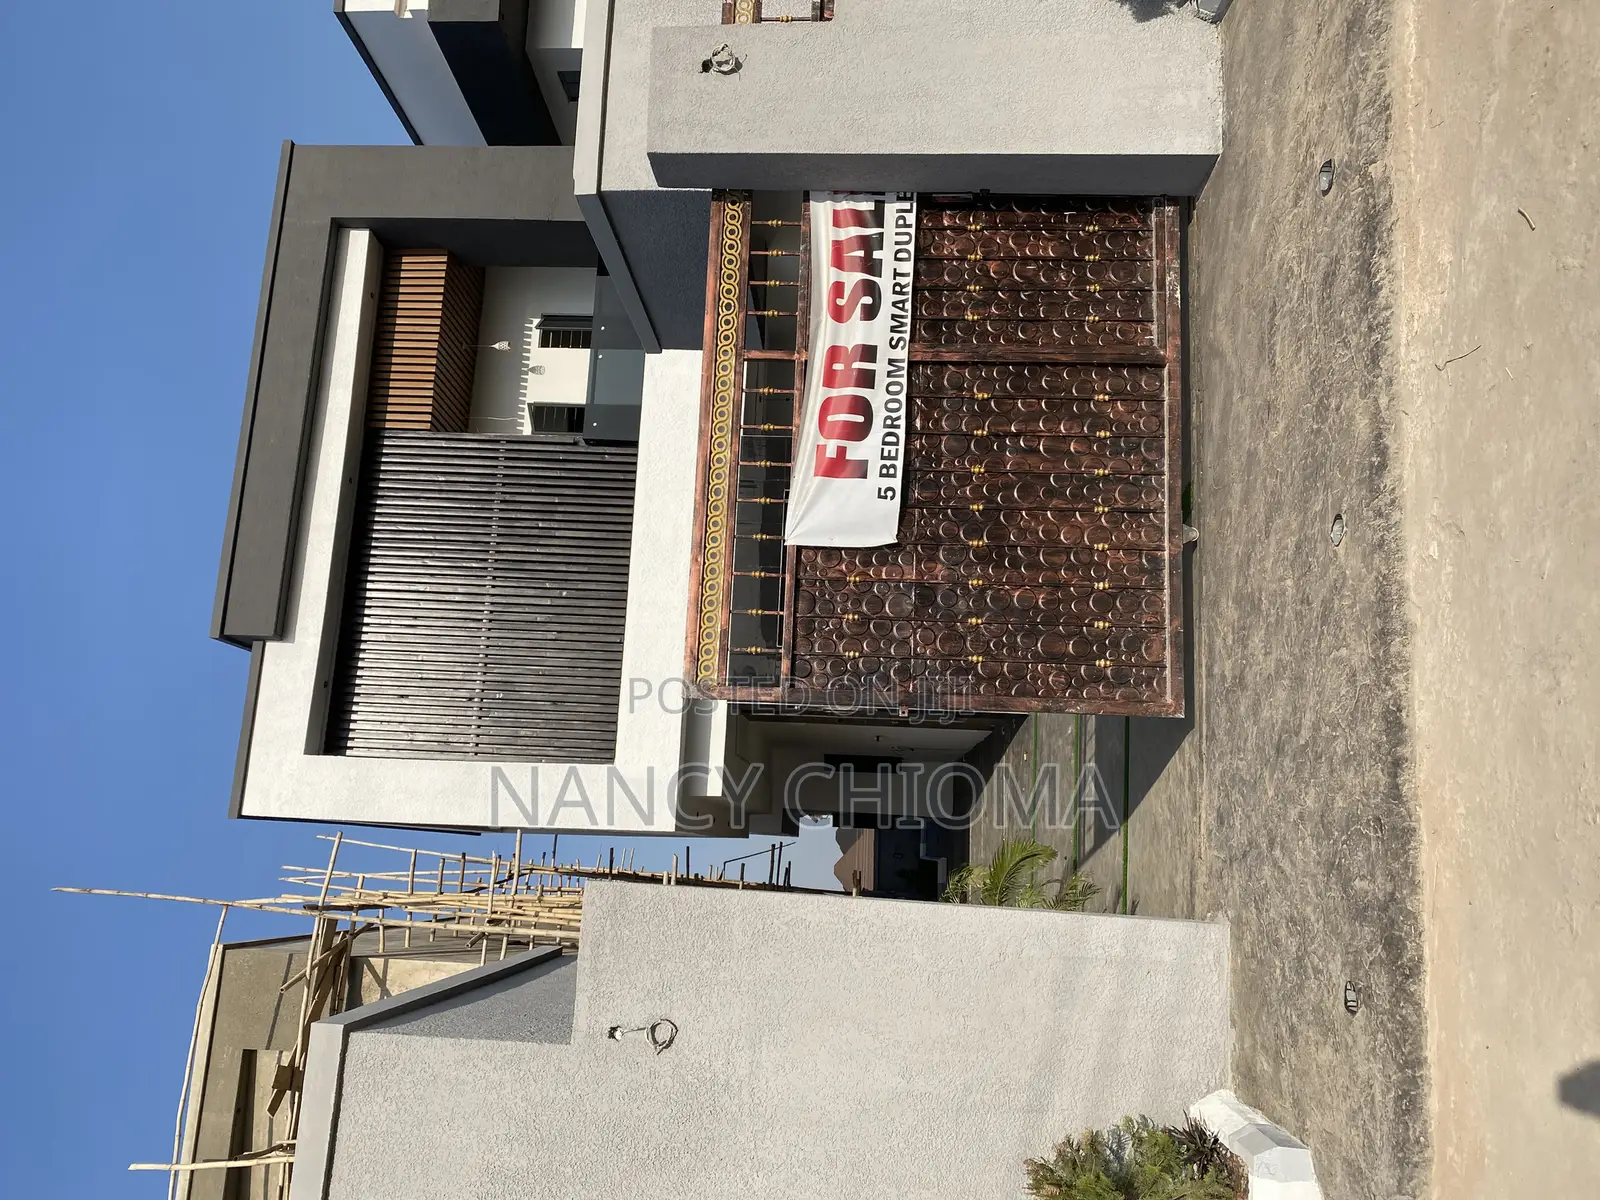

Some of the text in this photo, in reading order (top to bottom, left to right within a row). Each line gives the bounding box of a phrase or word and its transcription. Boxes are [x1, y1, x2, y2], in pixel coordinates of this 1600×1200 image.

[814, 191, 885, 479] FOR SAL
[888, 268, 910, 351] SMART
[878, 358, 906, 479] BEDROOM
[877, 486, 896, 501] 5
